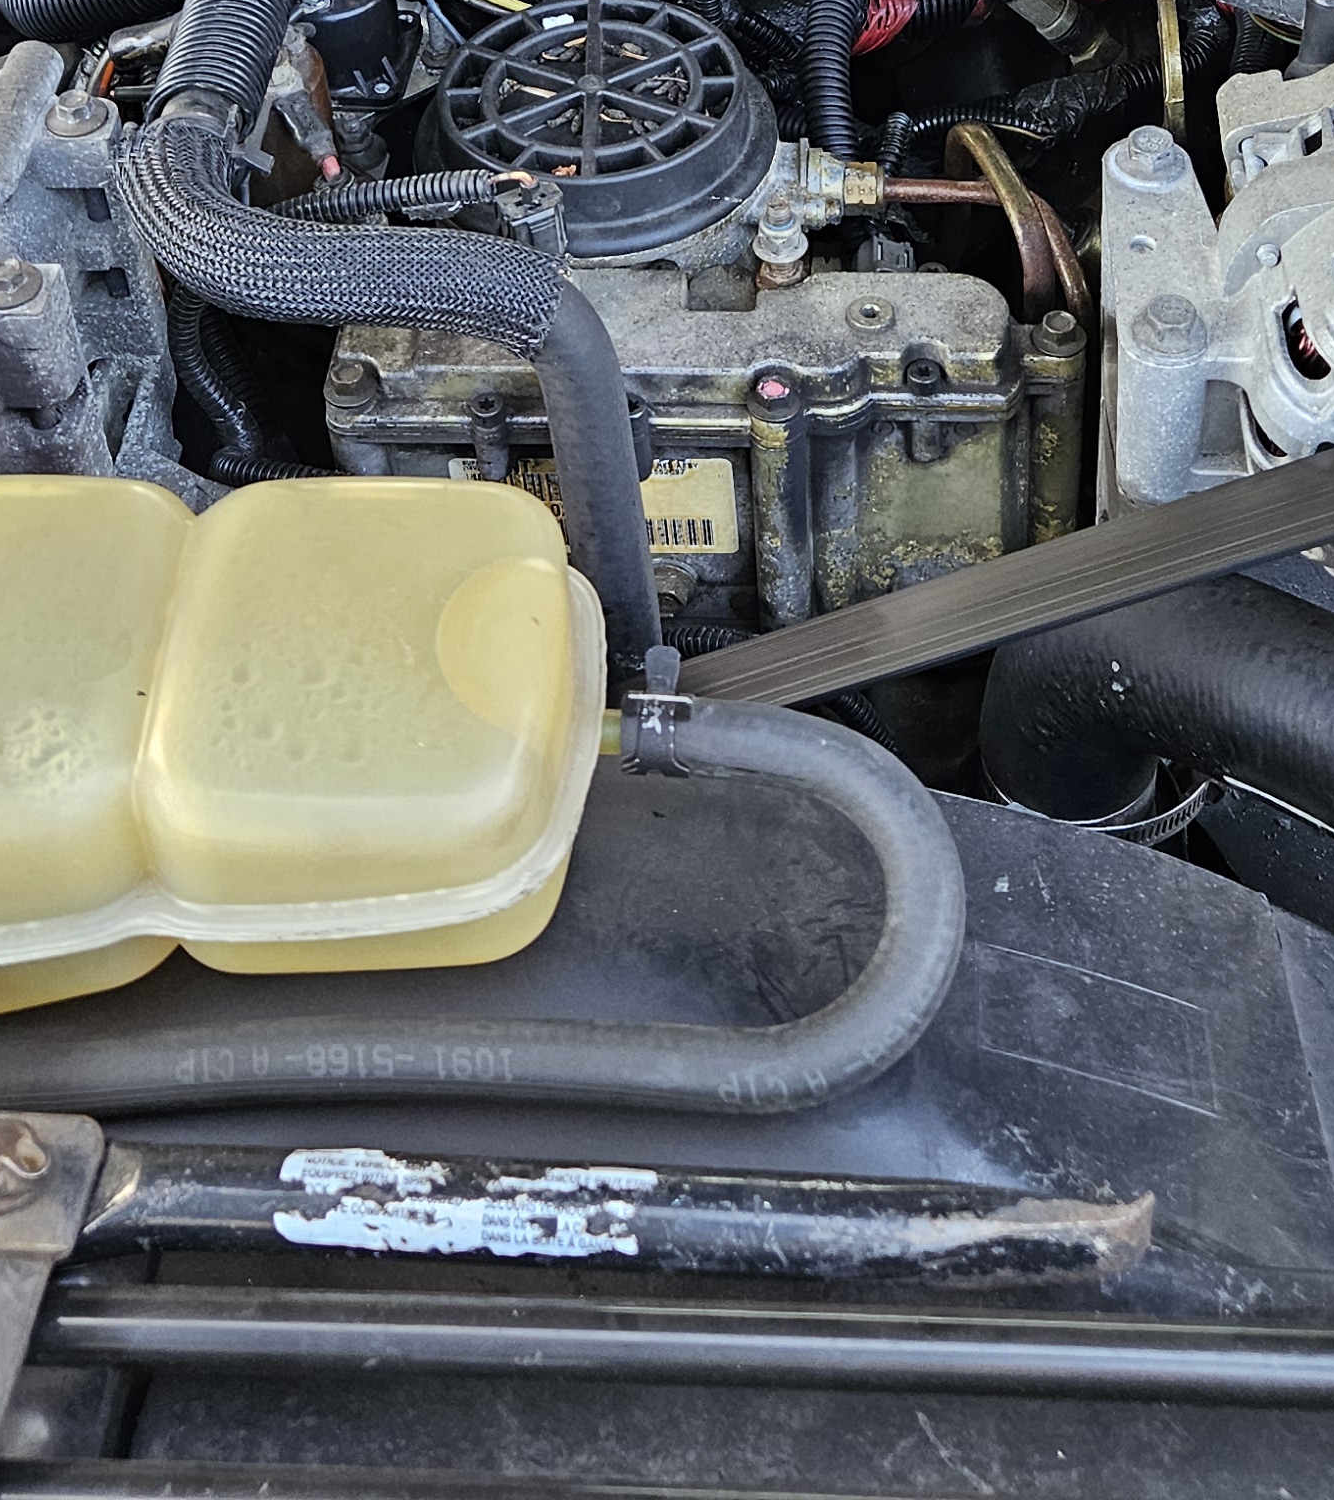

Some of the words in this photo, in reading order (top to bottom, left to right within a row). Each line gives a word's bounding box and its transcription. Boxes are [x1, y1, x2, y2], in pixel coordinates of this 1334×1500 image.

[302, 1167, 359, 1180] EQUIPPED
[361, 1172, 389, 1183] WITH
[482, 1213, 511, 1227] DANS
[481, 1230, 511, 1243] DANS
[514, 1231, 528, 1244] LA
